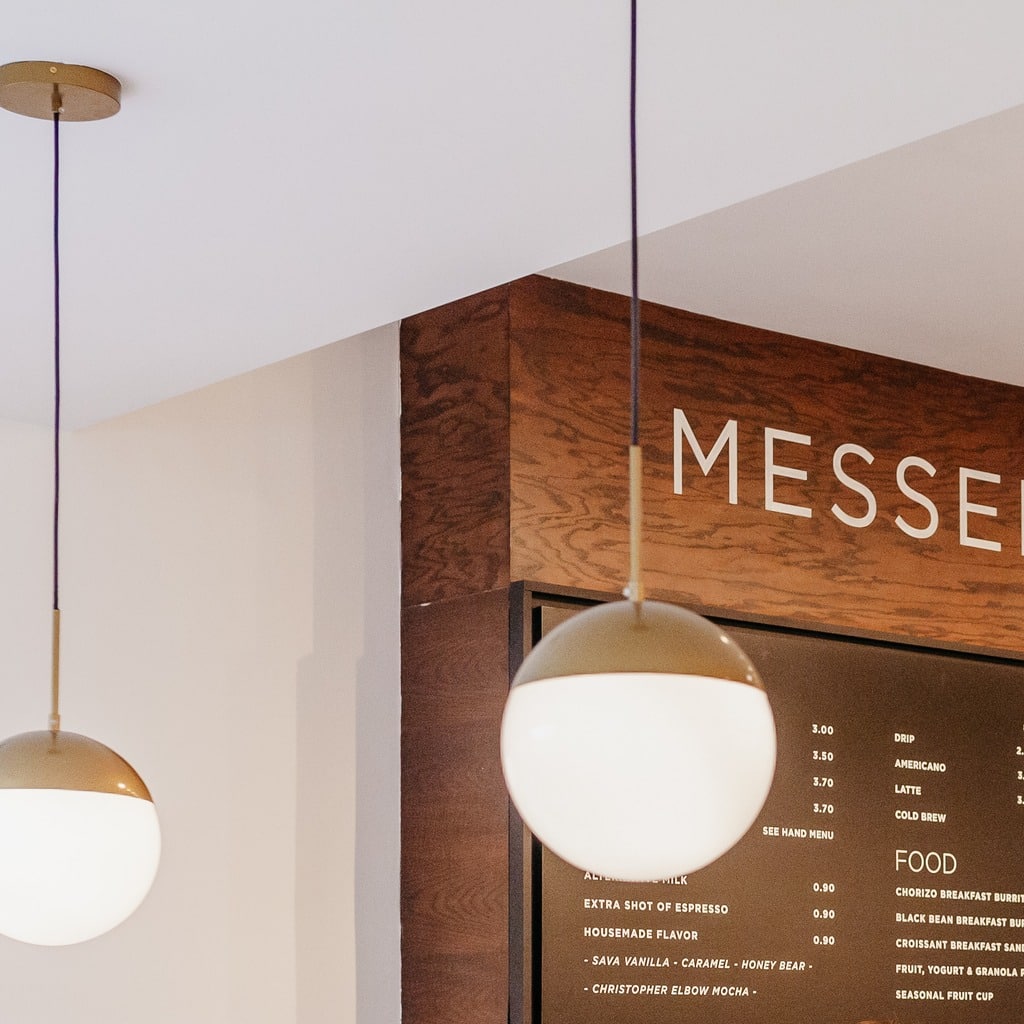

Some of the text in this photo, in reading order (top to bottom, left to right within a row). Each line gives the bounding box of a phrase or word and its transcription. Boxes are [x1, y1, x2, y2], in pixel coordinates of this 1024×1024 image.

[812, 724, 834, 735] 3.00
[894, 733, 915, 744] DRIP
[813, 750, 834, 762] 3.50
[894, 758, 947, 773] AMERICANO
[813, 777, 834, 788] 3.70
[894, 784, 922, 795] LATTE
[813, 803, 834, 814] 3.70
[895, 810, 947, 823] COLD BREW
[762, 826, 835, 840] SEE HAND MENU
[895, 849, 958, 875] FOOD
[813, 882, 836, 893] 0.90
[895, 887, 938, 899] CHORIZO
[940, 890, 992, 901] BREAKFAST
[584, 899, 729, 915] EXTRA SHOT OF ESPRESSO
[813, 908, 836, 919] 0.90
[895, 913, 926, 924] BLACK
[929, 915, 954, 924] BEAN
[956, 916, 1007, 927] BREAKFAST
[584, 927, 699, 941] HOUSEMADE FLAVOR
[813, 935, 836, 946] 0.90
[895, 939, 948, 949] CROISSANT
[950, 941, 1002, 951] BREAKFAST
[592, 956, 806, 971] SAVA VANILLA CARAMEL HONEY BEAR
[927, 966, 965, 975] YOGURT
[975, 967, 1018, 977] GRANOLA
[592, 984, 750, 997] CHRISTOPHER ELBOW MOCHA
[895, 990, 994, 1001] SEASONAL FRUIT CUP
